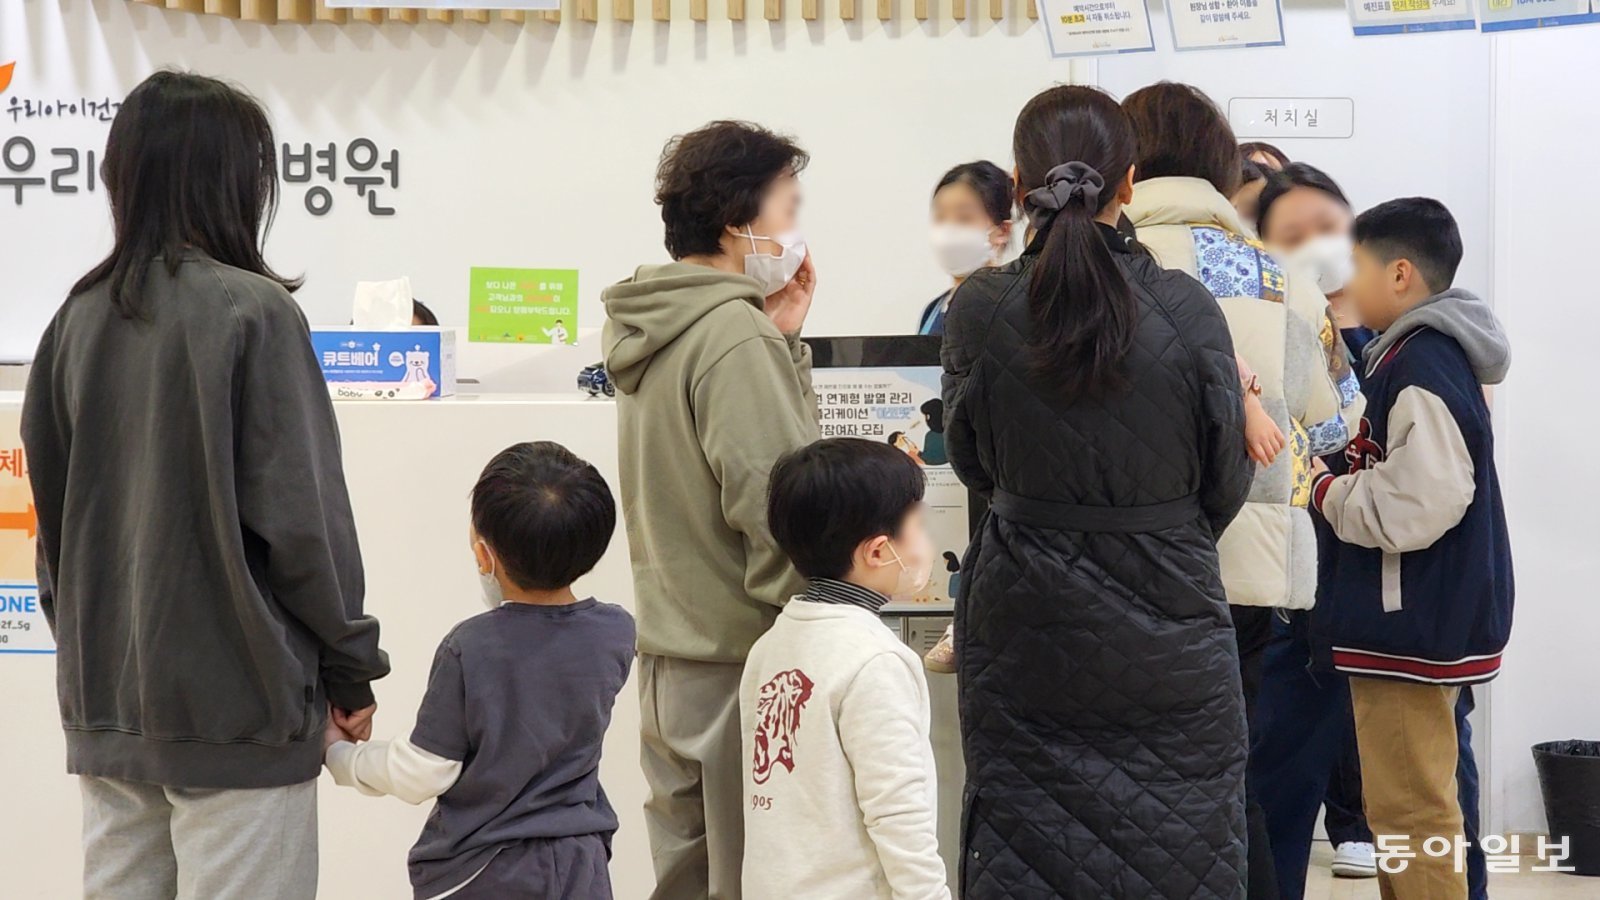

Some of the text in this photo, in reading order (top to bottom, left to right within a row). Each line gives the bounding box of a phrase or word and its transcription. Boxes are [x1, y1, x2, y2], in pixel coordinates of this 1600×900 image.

[282, 138, 399, 216] 병원
[323, 351, 379, 366] 큐트베어
[827, 392, 860, 405] 연계형
[864, 393, 886, 404] 발열
[889, 392, 912, 404] 관리
[861, 424, 884, 436] 모집
